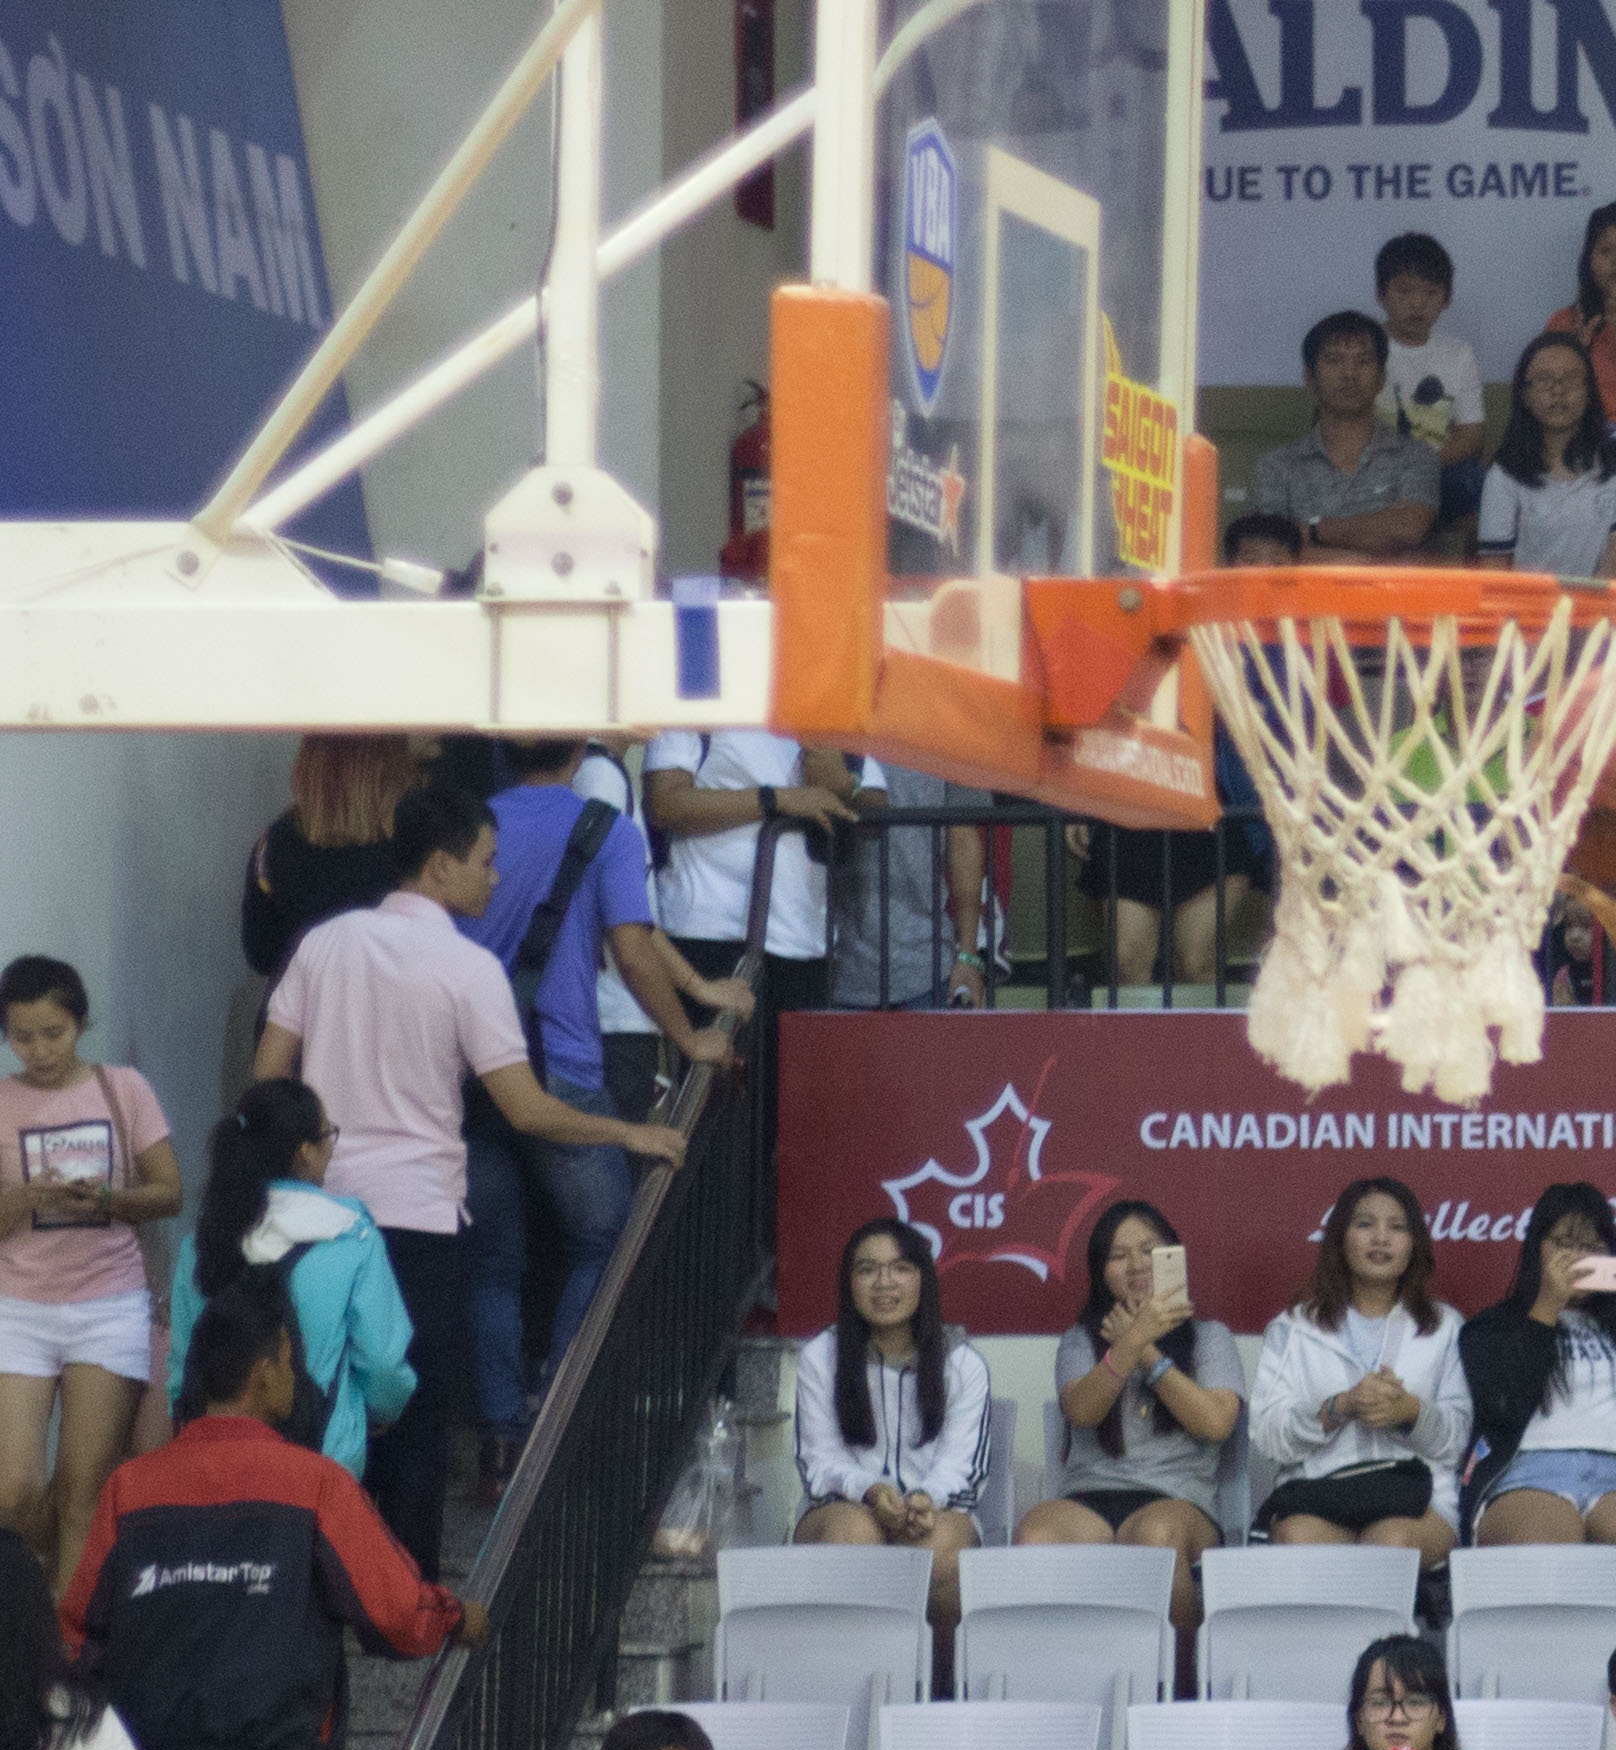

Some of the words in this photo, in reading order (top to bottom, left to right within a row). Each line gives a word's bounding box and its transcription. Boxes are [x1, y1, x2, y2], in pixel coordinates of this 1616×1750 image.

[149, 98, 327, 333] NAM
[911, 144, 951, 266] VBA
[1204, 165, 1263, 201] UE
[1276, 166, 1331, 201] TO
[1346, 164, 1432, 200] THE
[1103, 370, 1178, 492] SAIGON
[1140, 1111, 1376, 1150] CANADIAN
[948, 1193, 1005, 1229] CIS
